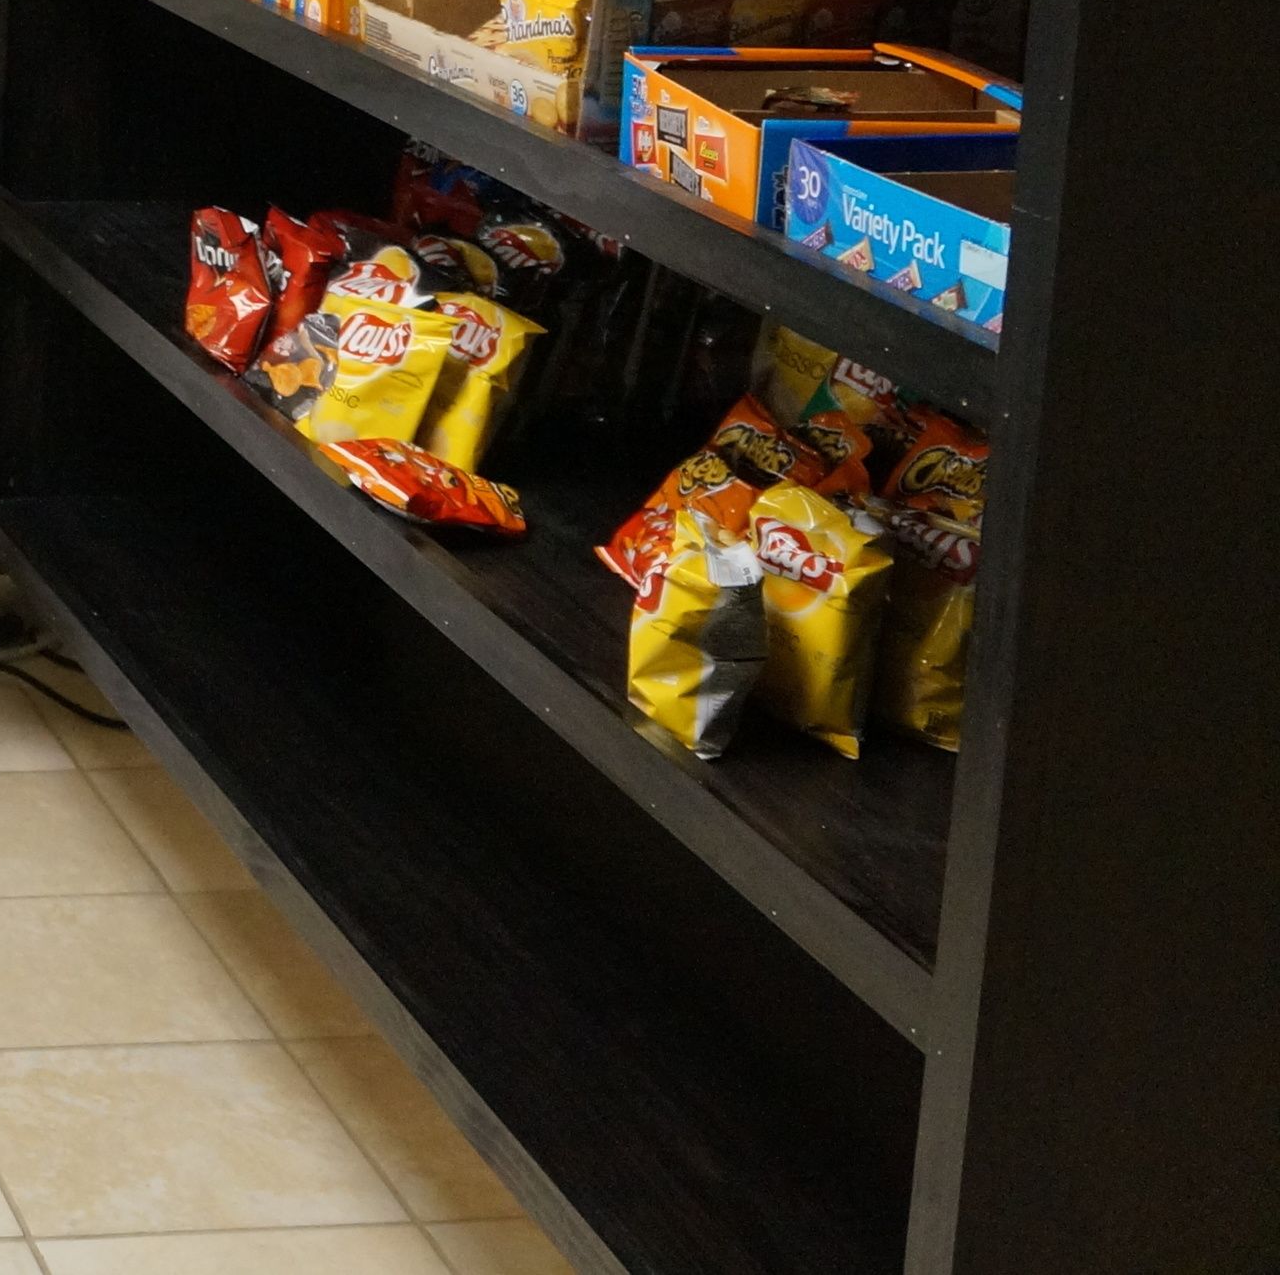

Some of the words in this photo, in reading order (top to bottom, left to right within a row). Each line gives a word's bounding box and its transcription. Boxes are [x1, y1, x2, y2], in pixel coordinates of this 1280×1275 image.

[502, 5, 576, 41] Grandma's
[512, 85, 524, 105] 36
[797, 166, 821, 199] 30
[842, 191, 900, 255] Variety
[901, 219, 945, 269] Pack
[340, 315, 412, 363] Lay's
